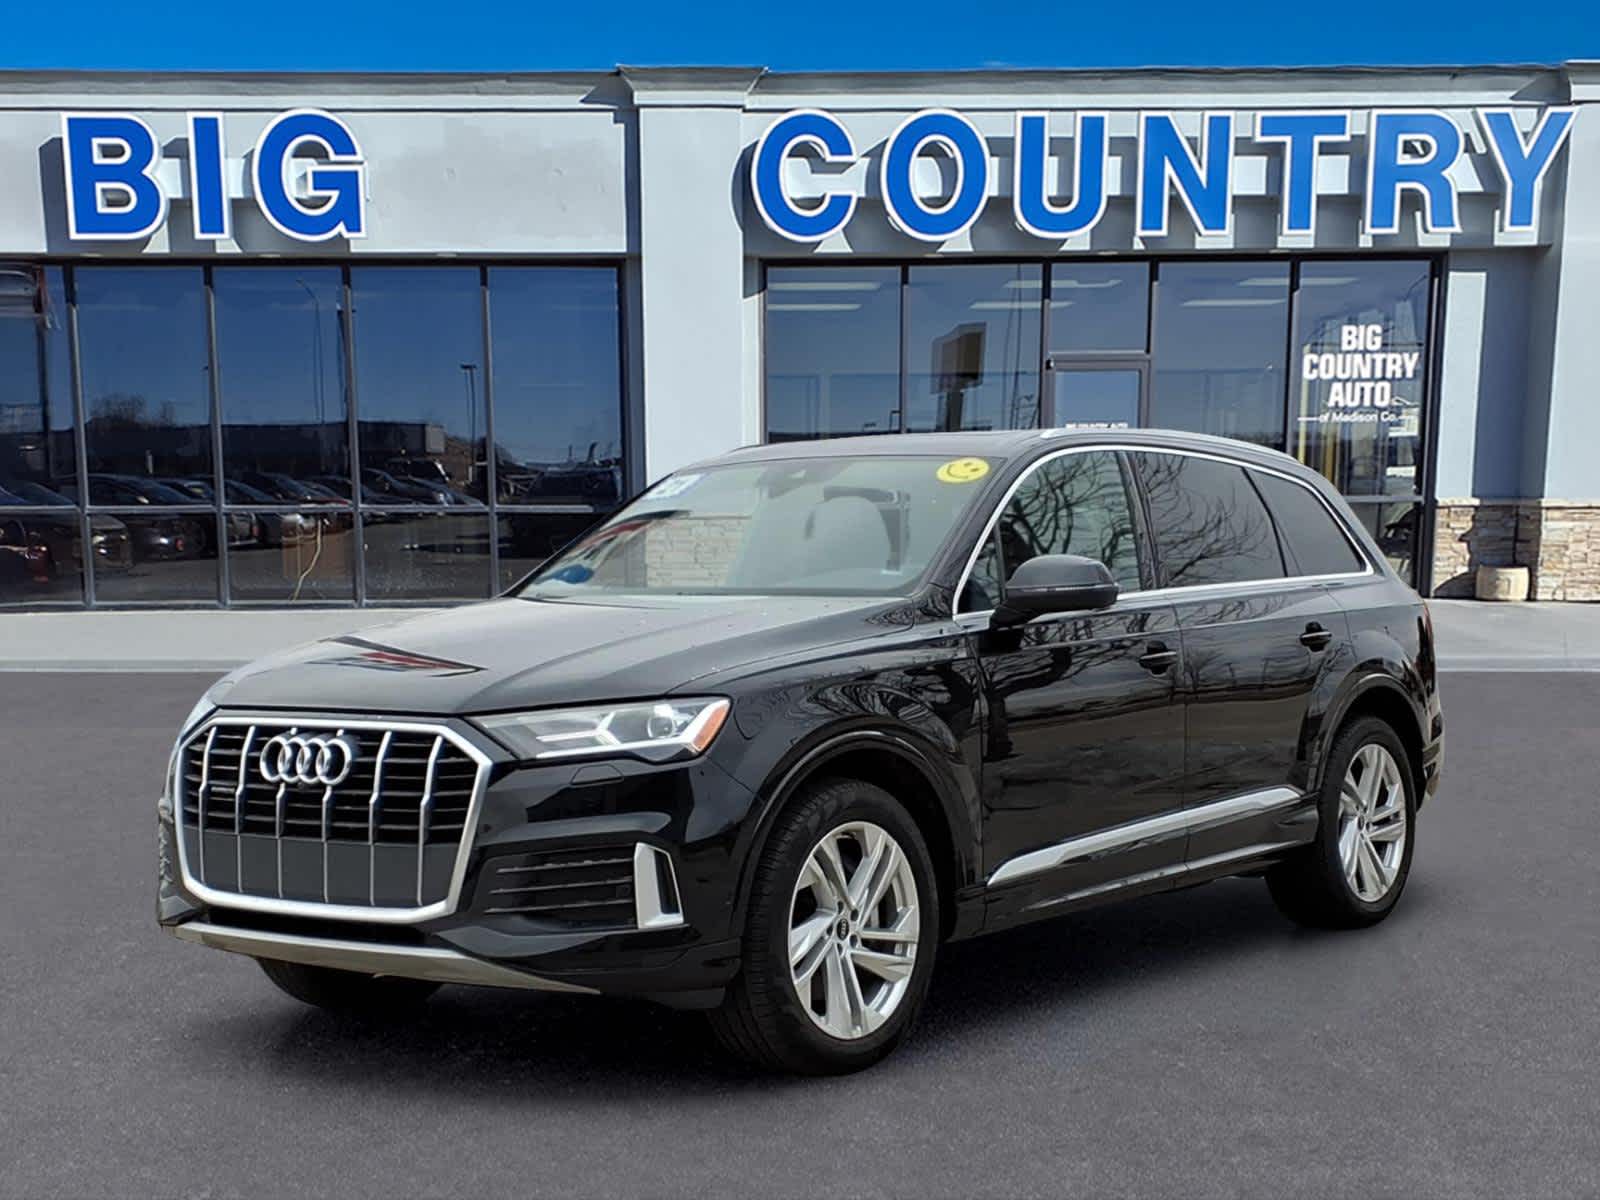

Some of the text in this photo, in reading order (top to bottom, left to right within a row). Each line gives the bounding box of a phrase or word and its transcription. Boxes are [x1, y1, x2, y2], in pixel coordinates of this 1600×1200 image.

[60, 105, 1579, 243] BIG COUNTRY
[1341, 324, 1383, 351] BIG
[1302, 352, 1420, 380] COUNTRY
[1327, 381, 1392, 407] AUTO
[1319, 412, 1330, 422] of
[1331, 411, 1379, 422] Madison
